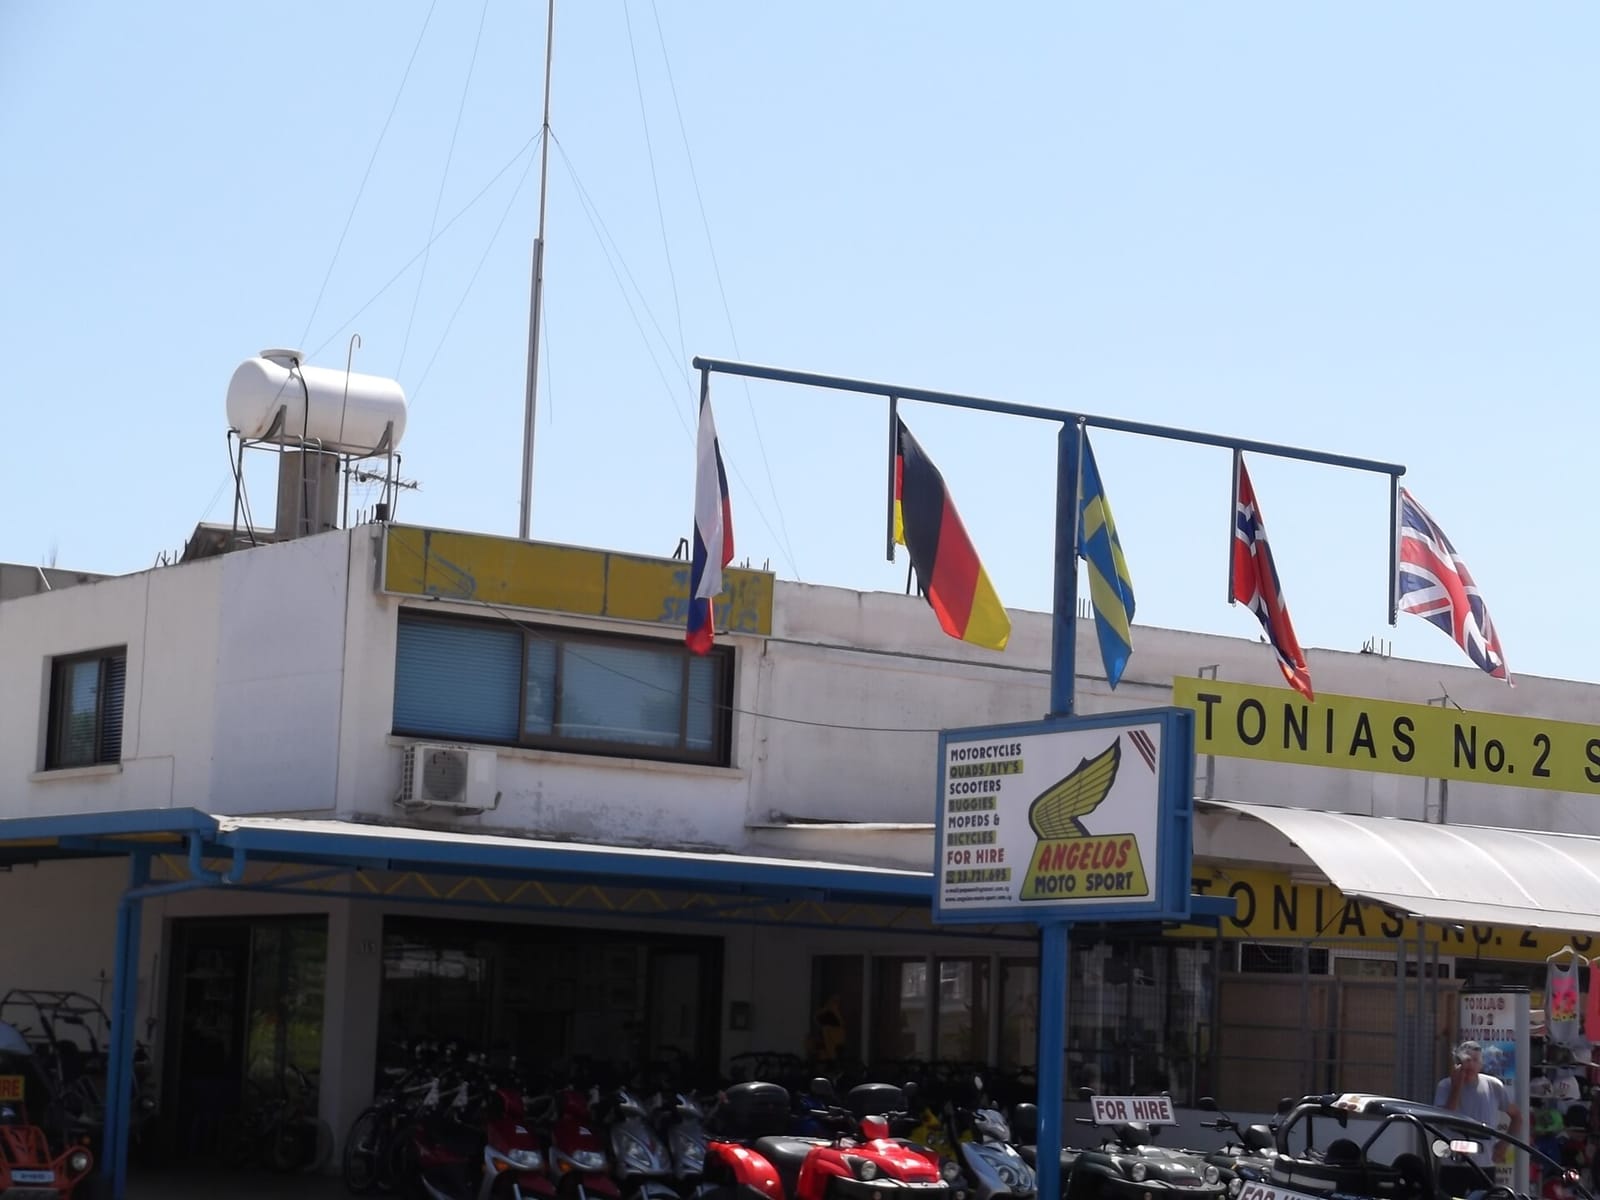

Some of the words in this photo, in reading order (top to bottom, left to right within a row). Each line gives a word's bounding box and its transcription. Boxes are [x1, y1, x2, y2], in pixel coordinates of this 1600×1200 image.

[1197, 692, 1416, 764] TONIAS
[1453, 723, 1515, 774] No.
[1532, 733, 1552, 778] 2
[950, 743, 1022, 762] MOTORCYCLES
[949, 760, 1019, 778] QUADS/ATV'S
[949, 779, 1002, 795] SCOOTERS
[948, 796, 994, 812] BUGGIES
[948, 813, 990, 829] MOPEDS
[993, 812, 1000, 826] &
[947, 830, 993, 847] BICYCLES
[946, 849, 971, 865] FOR
[976, 847, 1005, 864] HIRE
[1037, 839, 1132, 873] ANGELOS
[1034, 874, 1076, 895] MOTO
[1086, 871, 1133, 892] SPORT
[1464, 997, 1505, 1010] TONIAS
[1096, 1100, 1128, 1121] FOR
[1132, 1100, 1171, 1121] HIRE
